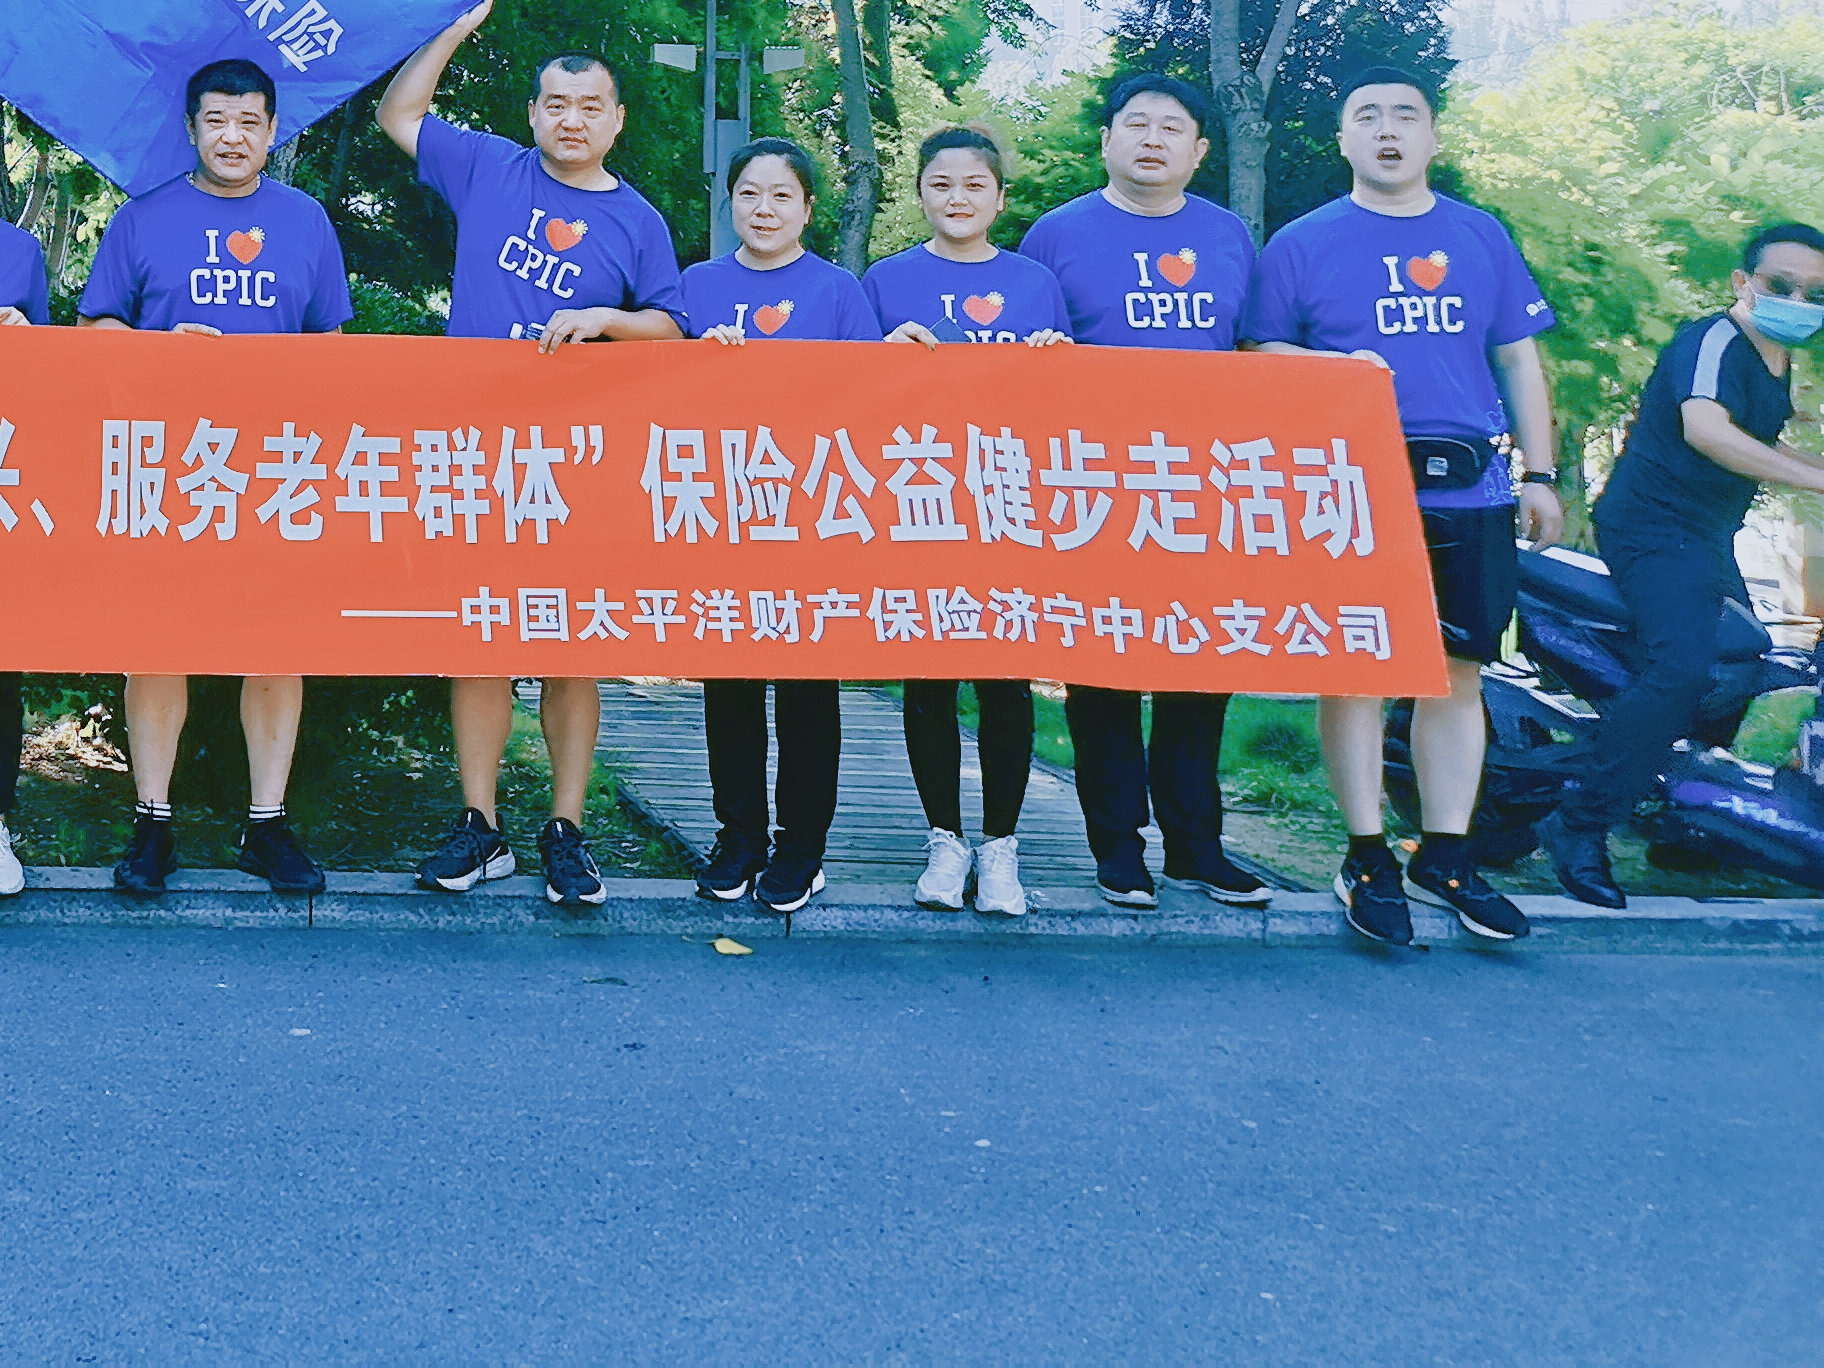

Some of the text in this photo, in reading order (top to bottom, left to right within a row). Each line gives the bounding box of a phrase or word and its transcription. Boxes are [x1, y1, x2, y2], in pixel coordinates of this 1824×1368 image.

[527, 208, 546, 240] I
[205, 229, 220, 263] I
[498, 235, 582, 299] CPIC
[1133, 253, 1153, 287] I
[1382, 256, 1405, 293] I
[190, 268, 276, 307] CPIC
[734, 304, 749, 335] I
[940, 294, 957, 324] I
[1125, 292, 1216, 329] CPIC
[1375, 296, 1466, 335] CPIC
